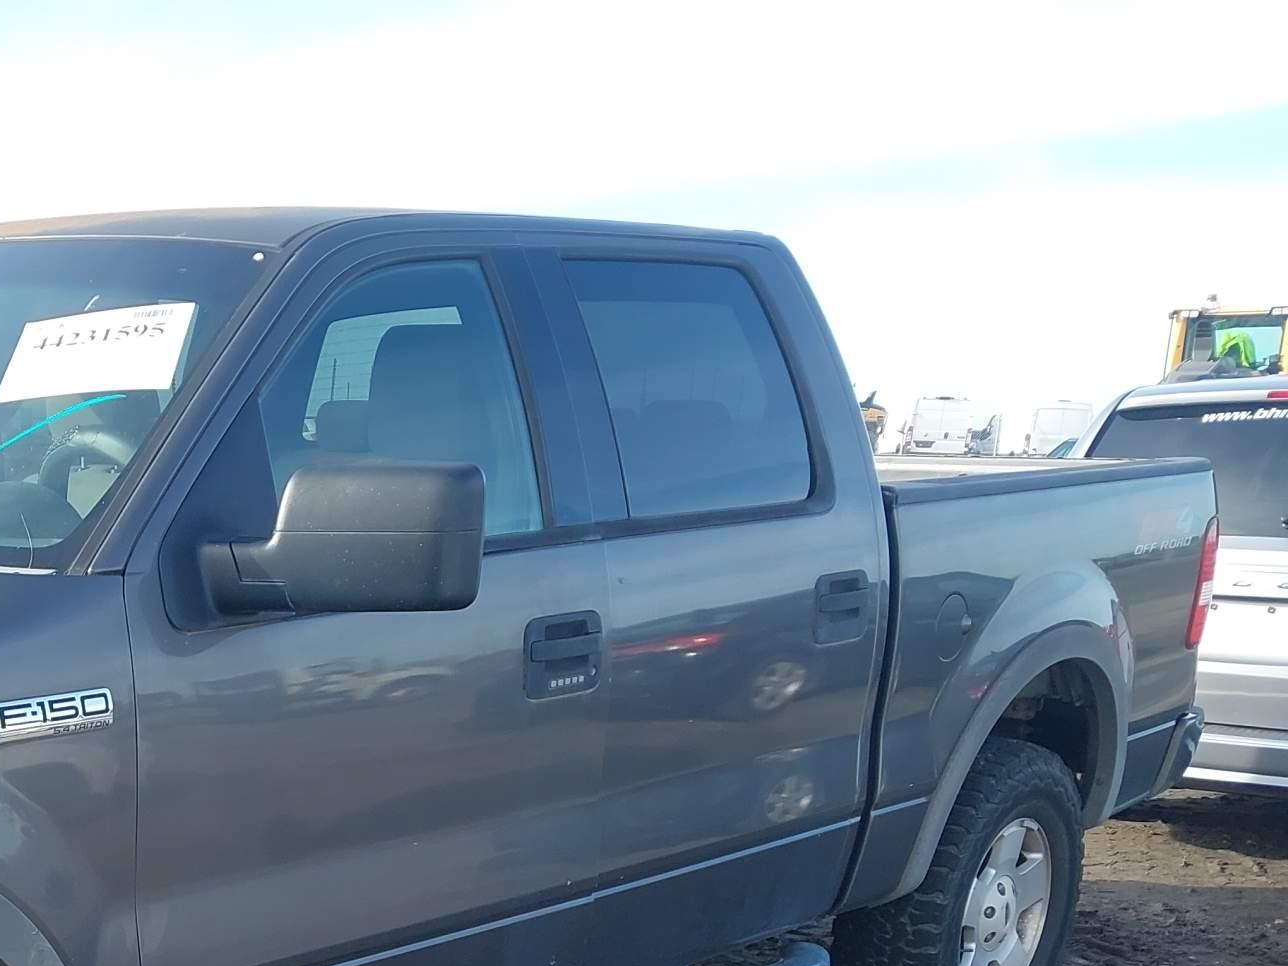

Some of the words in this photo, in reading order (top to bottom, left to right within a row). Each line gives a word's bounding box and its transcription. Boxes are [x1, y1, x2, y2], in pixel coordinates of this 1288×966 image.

[33, 322, 167, 350] 44231595
[1134, 543, 1158, 556] OFF
[1160, 536, 1193, 551] ROAD
[73, 719, 110, 732] TRITON
